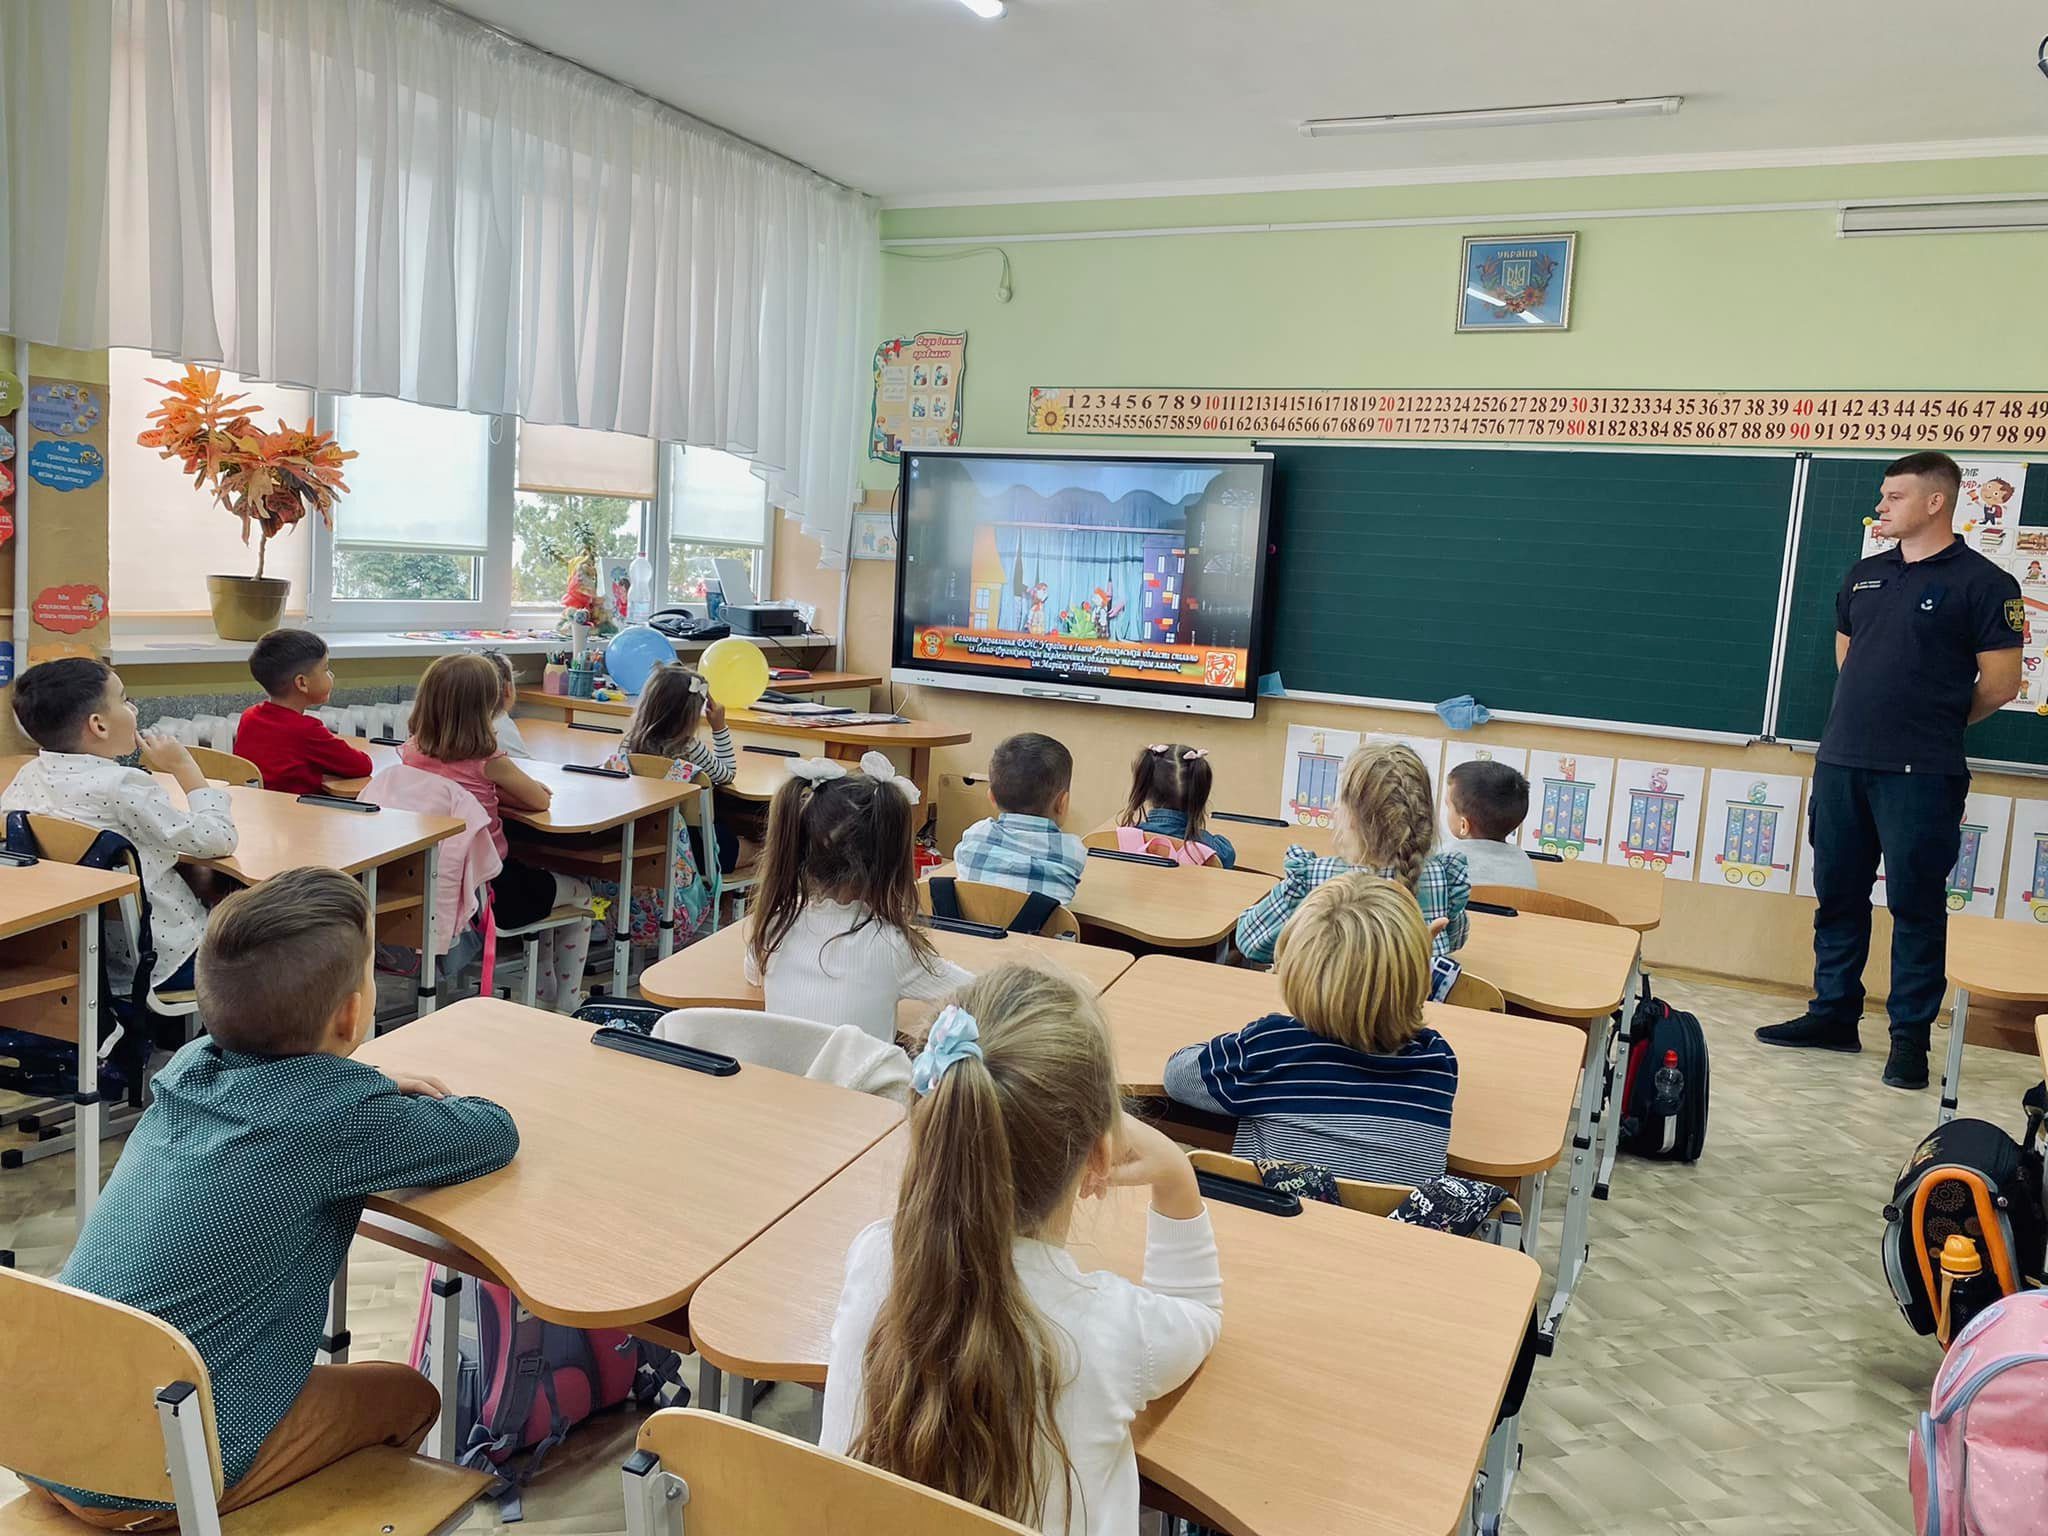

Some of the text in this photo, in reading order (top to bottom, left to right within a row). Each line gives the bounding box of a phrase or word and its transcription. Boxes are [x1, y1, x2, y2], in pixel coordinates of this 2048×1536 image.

[1069, 395, 2048, 419] 1 2 3 4 5 6 7 8 9 10 11 12 13 14 15 16 17 18 19 20 21 22 23 24 25 26 27 28 29 30 31 32 33 34 35 36 37 38 39 40 41 42 43 44 45 46 47 48 49
[1062, 414, 2046, 443] 51 52 53 54 55 56 57 58 59 60 61 62 63 64 65 66 67 68 69 70 71 72 73 74 75 76 77 78 79 80 81 82 83 84 85 86 87 88 89 90 91 92 93 94 95 96 97 98 99
[1559, 755, 1576, 781] 4
[1650, 768, 1670, 793] 5
[1747, 781, 1768, 805] 6
